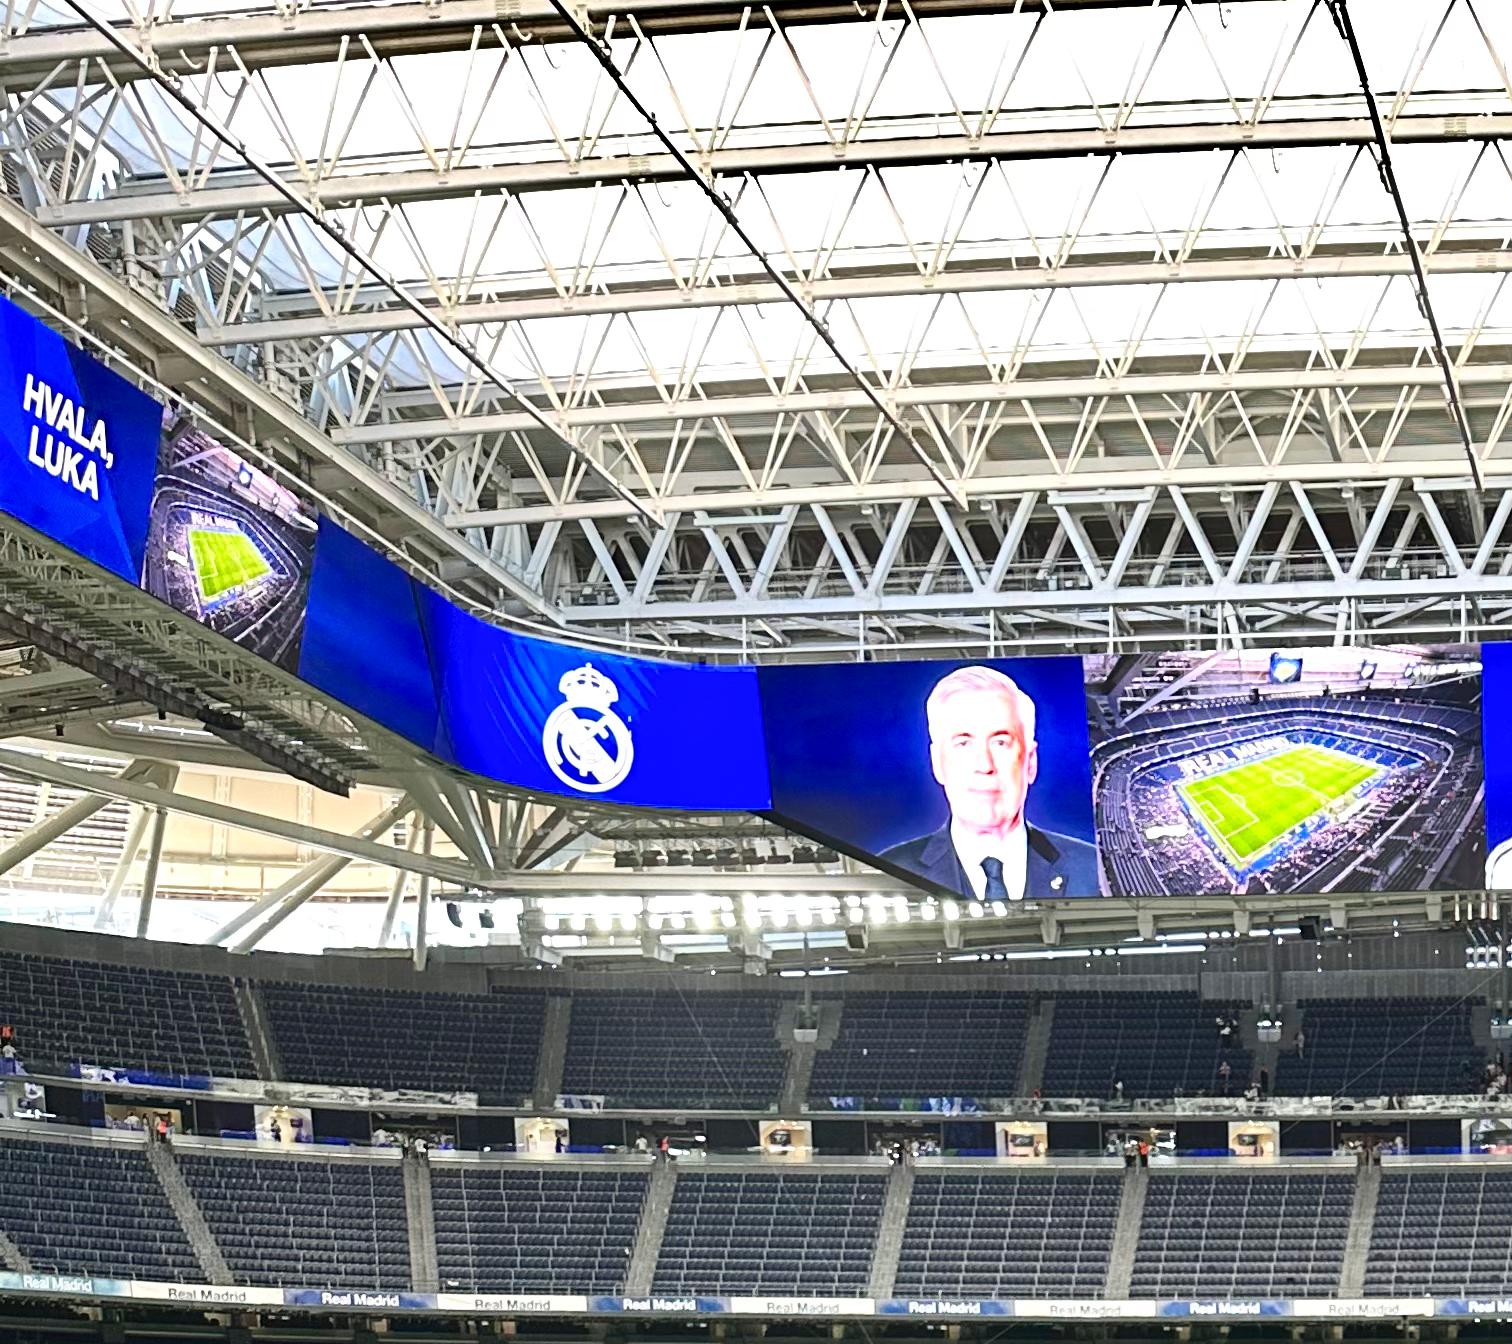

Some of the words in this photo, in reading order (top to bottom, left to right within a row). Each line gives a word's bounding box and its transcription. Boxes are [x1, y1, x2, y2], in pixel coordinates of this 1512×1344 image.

[23, 373, 113, 469] HVALA,
[29, 425, 98, 501] LUKA
[168, 1288, 196, 1299] Real
[321, 1291, 351, 1305] Real
[353, 1293, 399, 1307] Madrid
[623, 1298, 651, 1310] Real
[652, 1299, 696, 1311] Madrid
[909, 1301, 937, 1313] Real
[1190, 1301, 1217, 1314] Real
[1468, 1301, 1496, 1312] Real
